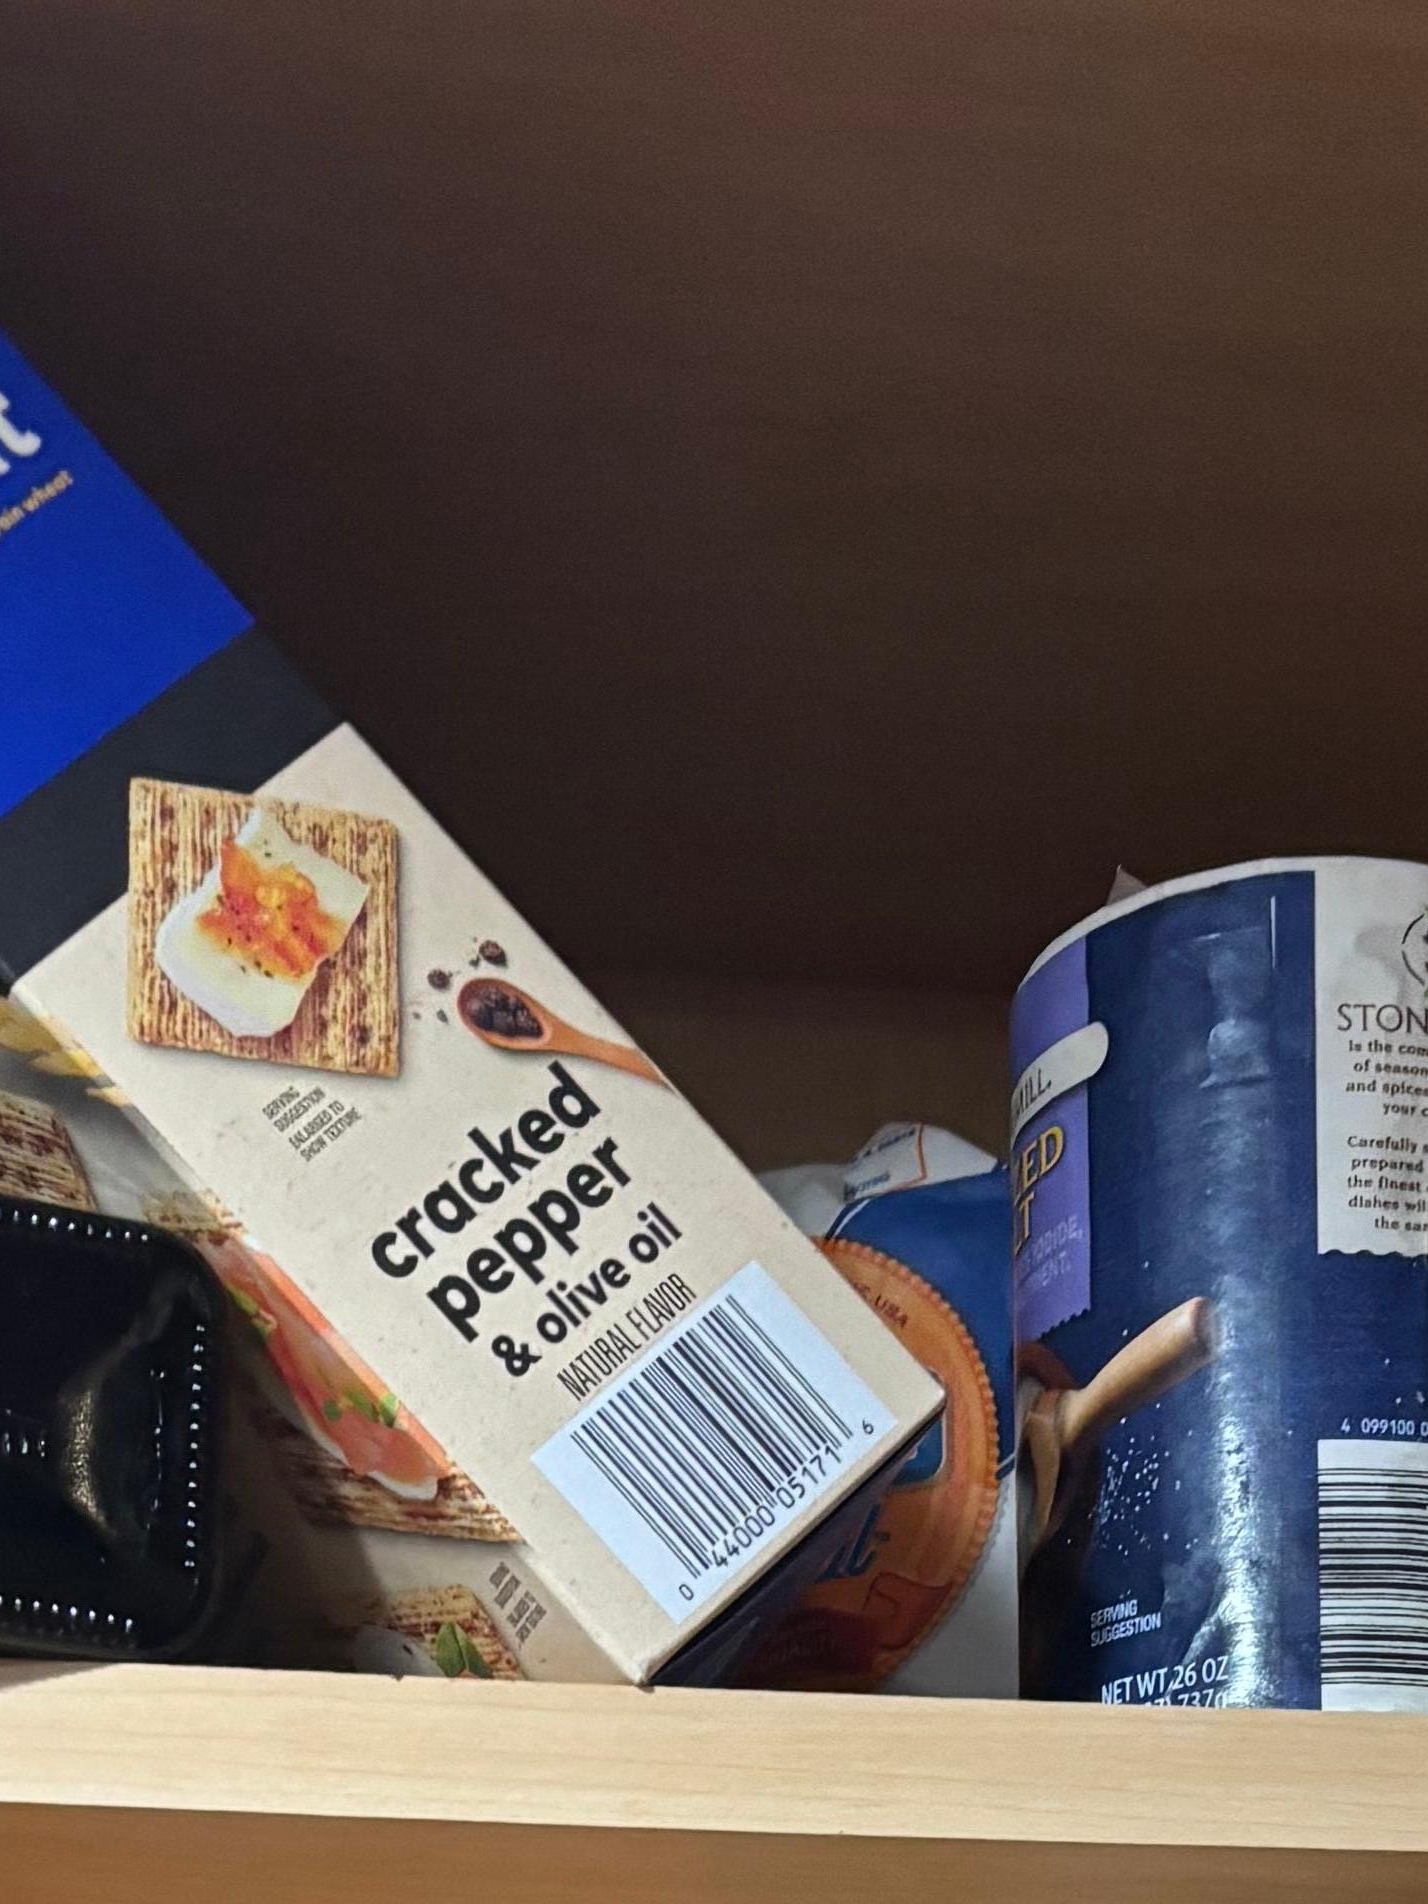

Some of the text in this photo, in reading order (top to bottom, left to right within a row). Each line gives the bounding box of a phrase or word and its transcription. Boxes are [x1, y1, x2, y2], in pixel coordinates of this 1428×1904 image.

[372, 1060, 602, 1277] cracked
[1347, 1135, 1417, 1153] Carefully
[426, 1136, 631, 1342] pepper
[491, 1202, 683, 1377] & olive oil
[557, 1271, 697, 1401] NATURAL FLAVOR
[712, 1505, 775, 1568] 44000
[1101, 1674, 1135, 1705] NET
